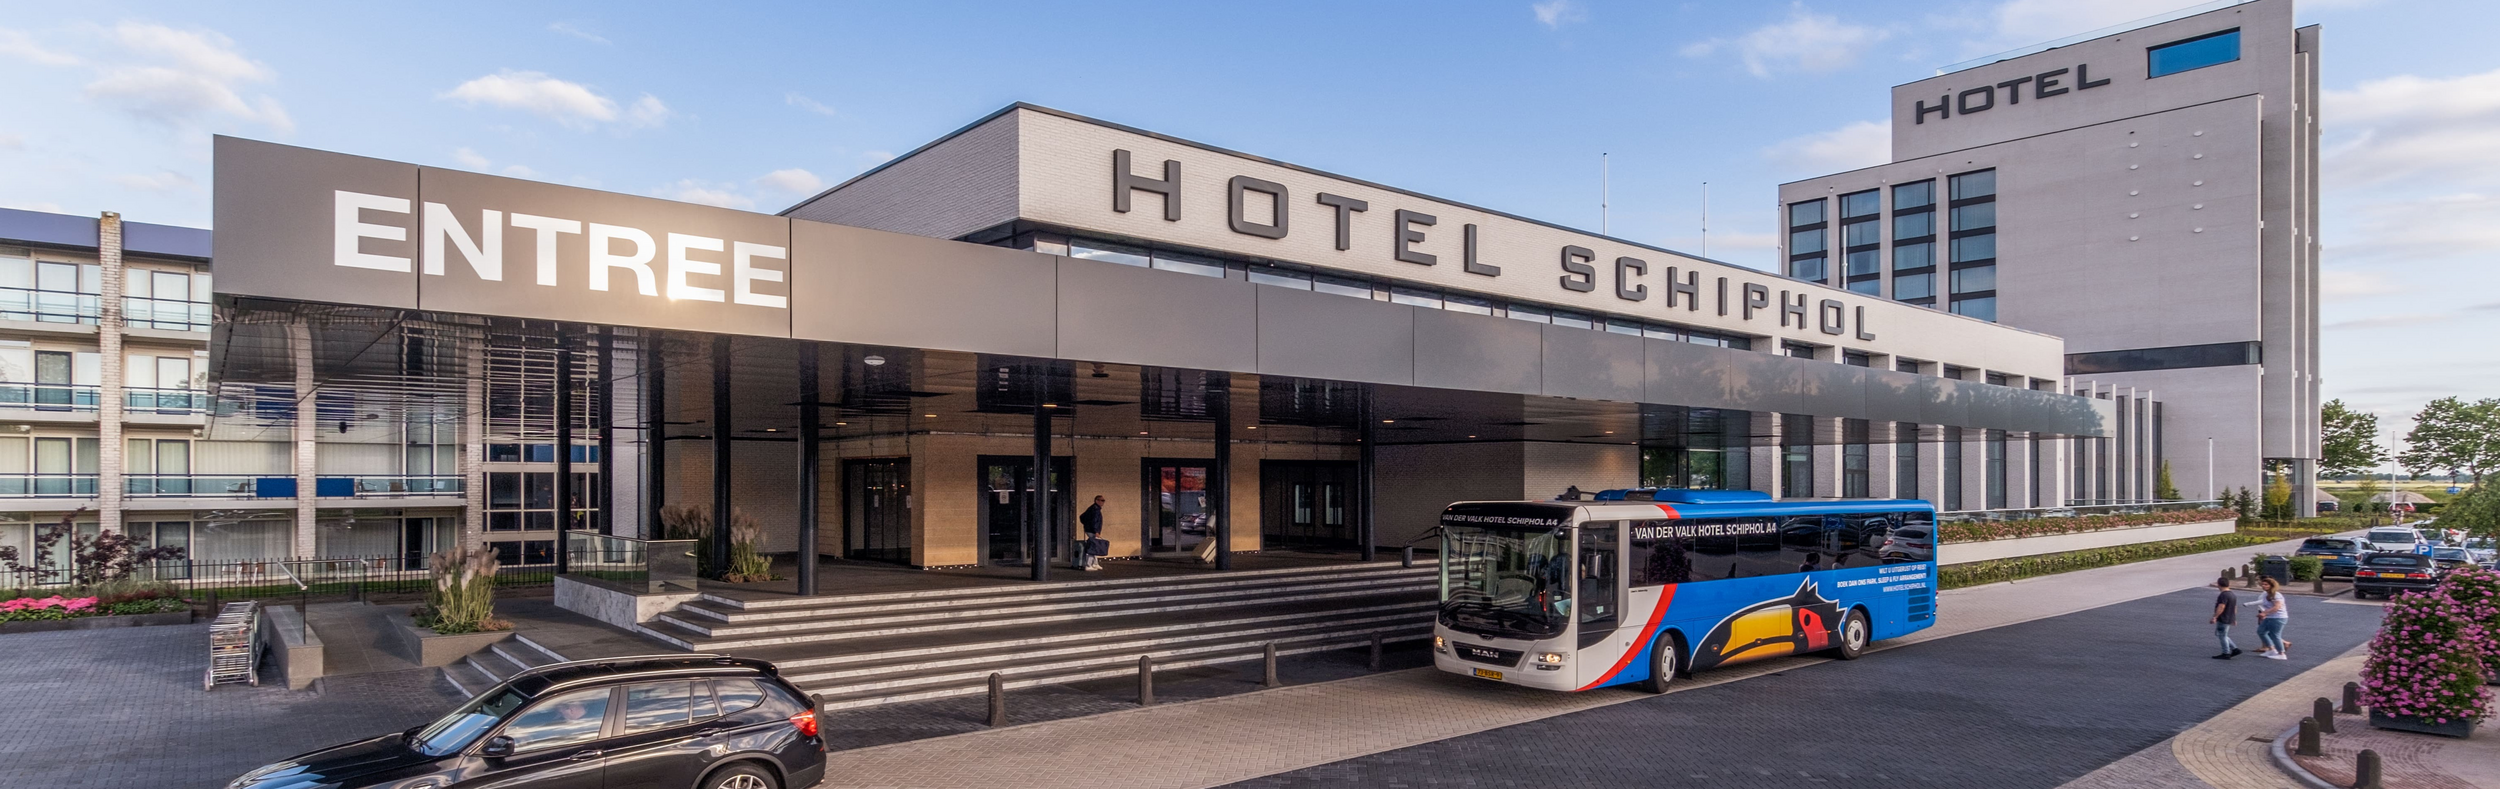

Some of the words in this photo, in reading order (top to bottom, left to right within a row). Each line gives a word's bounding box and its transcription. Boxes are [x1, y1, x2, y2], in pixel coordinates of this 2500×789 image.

[1916, 63, 2111, 125] HOTEL
[334, 189, 787, 308] ENTREE
[1113, 148, 1501, 277] HOTEL
[1559, 244, 1876, 341] SCHIPHOL
[1453, 514, 1467, 522] DER
[1507, 517, 1545, 526] SCHIPHOL
[1545, 518, 1558, 526] A4
[1635, 527, 1654, 539] VAN
[1656, 526, 1674, 538] DER
[1675, 525, 1697, 538] VALK
[1698, 524, 1724, 536] HOTEL
[1726, 523, 1765, 535] SCHIPHOL
[1765, 522, 1777, 533] A4
[2418, 545, 2430, 554] P
[1472, 648, 1499, 658] MAN
